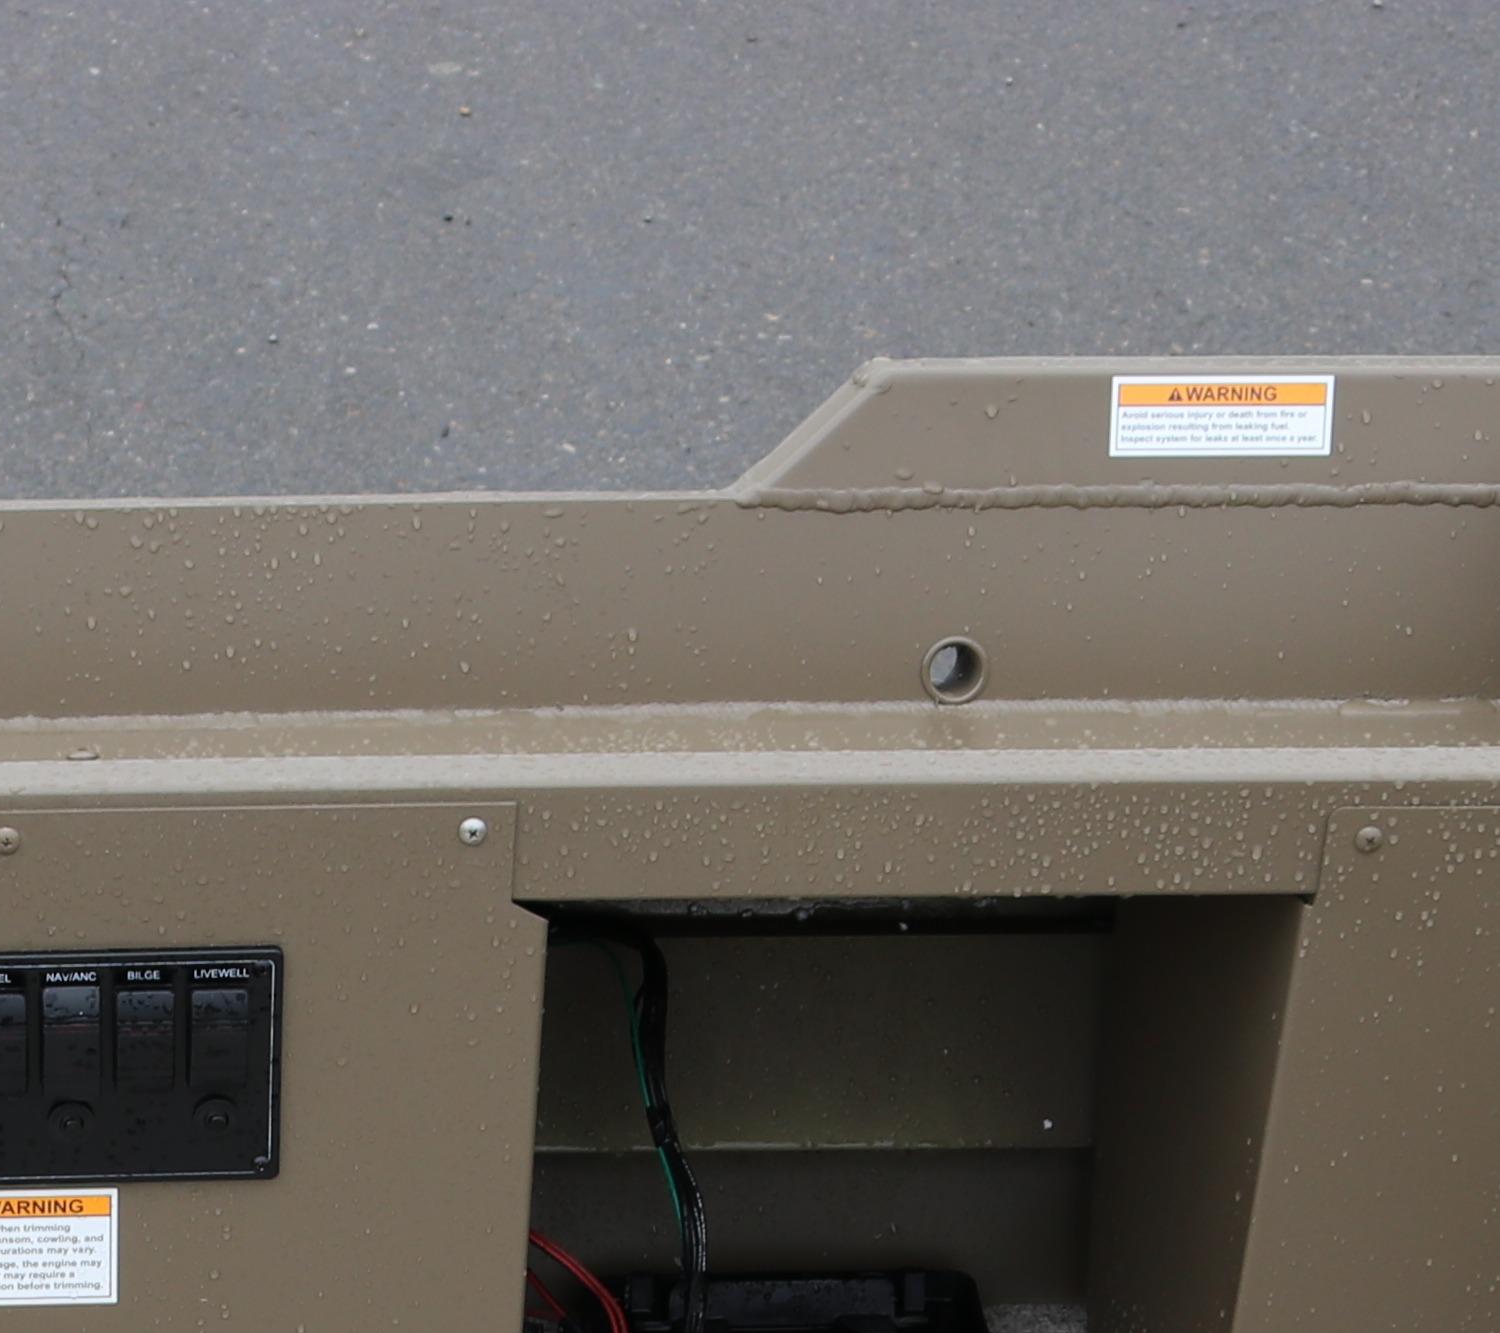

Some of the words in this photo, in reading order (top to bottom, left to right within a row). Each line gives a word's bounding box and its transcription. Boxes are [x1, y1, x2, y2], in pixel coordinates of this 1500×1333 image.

[1186, 386, 1277, 402] WARNING
[1187, 410, 1213, 421] injury
[1228, 410, 1253, 418] death
[1256, 410, 1277, 418] from
[1280, 409, 1294, 418] fire
[1121, 423, 1165, 432] explosion
[1168, 422, 1209, 432] resulting
[1211, 422, 1232, 430] from
[1235, 422, 1268, 432] leaking
[1120, 434, 1153, 444] Inspect
[1156, 435, 1188, 444] system
[1190, 434, 1203, 442] for
[1205, 434, 1228, 442] leaks
[1231, 434, 1240, 442] at
[1242, 433, 1263, 442] least
[1266, 434, 1287, 442] once
[46, 971, 97, 982] NAV/ANC
[127, 970, 160, 981] BILGE
[194, 967, 250, 979] LIVEWELL
[23, 1224, 71, 1233] trimming
[37, 1235, 81, 1244] cowling,
[84, 1234, 104, 1242] and
[47, 1247, 69, 1255] may
[72, 1247, 97, 1255] vary.
[22, 1260, 39, 1268] the
[42, 1259, 77, 1269] engine
[80, 1259, 102, 1268] may
[3, 1272, 26, 1281] may
[28, 1271, 66, 1280] require
[17, 1281, 50, 1291] before
[53, 1281, 104, 1290] trimming.
